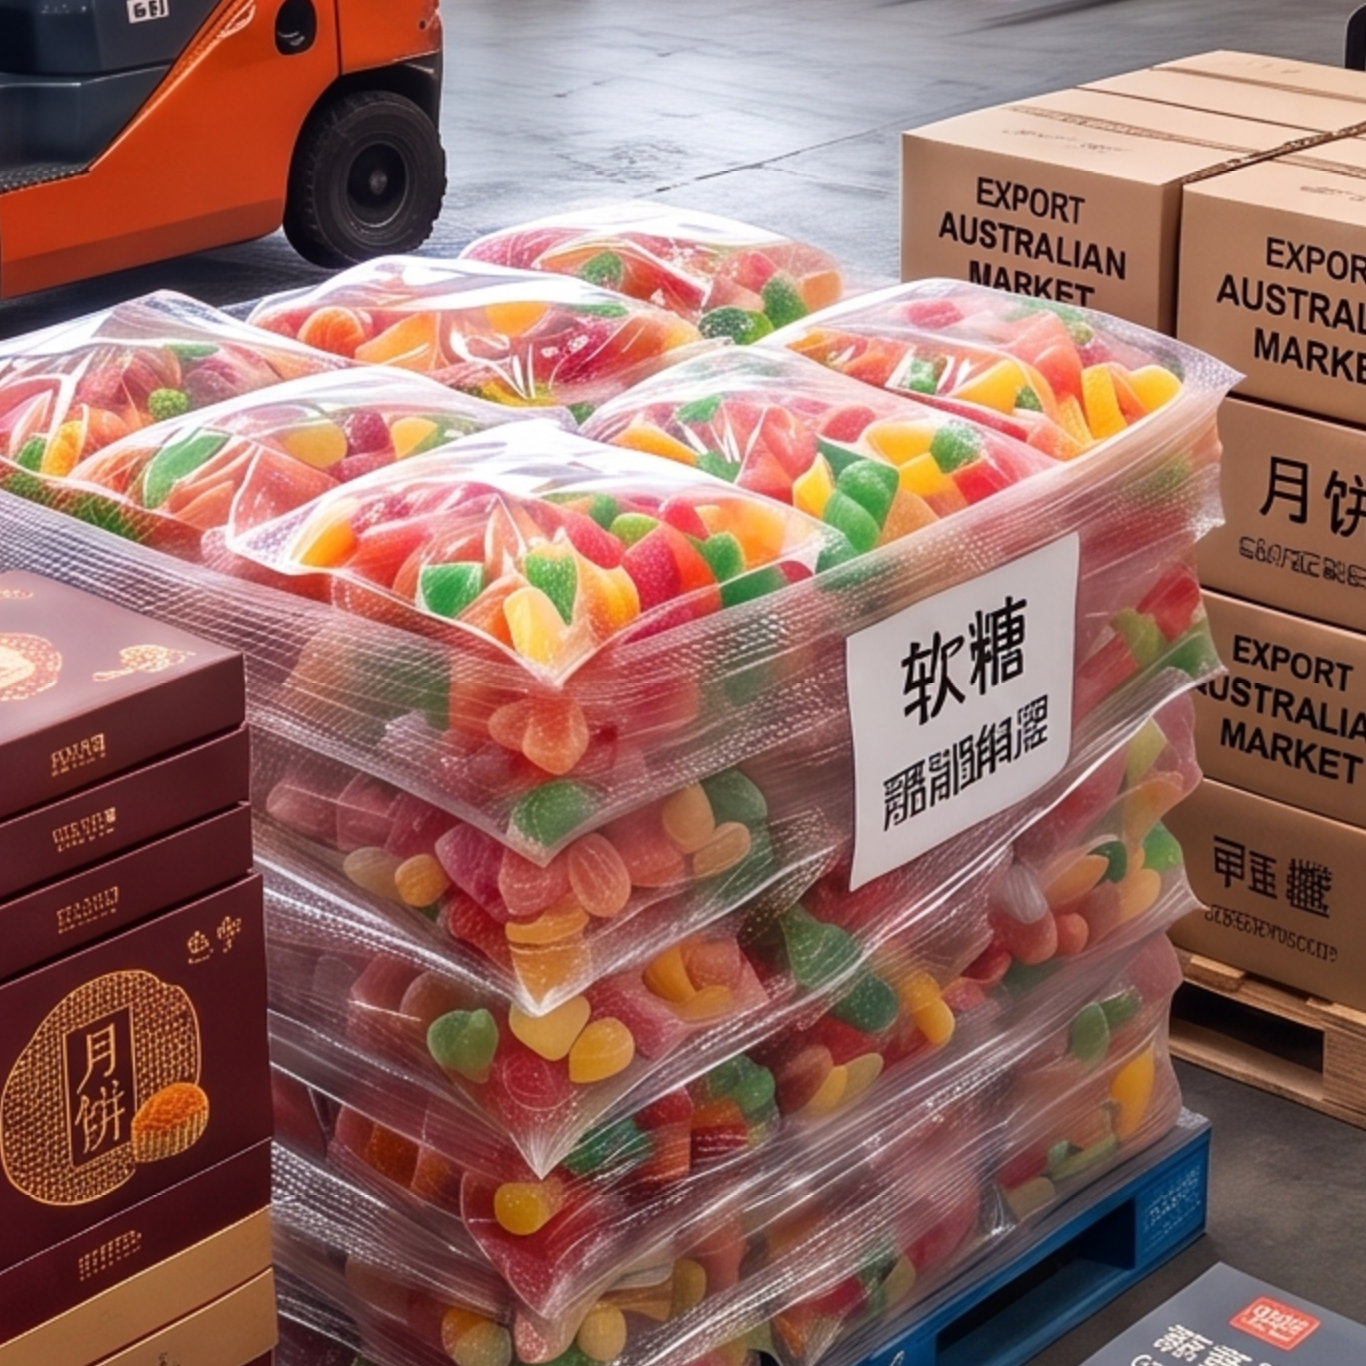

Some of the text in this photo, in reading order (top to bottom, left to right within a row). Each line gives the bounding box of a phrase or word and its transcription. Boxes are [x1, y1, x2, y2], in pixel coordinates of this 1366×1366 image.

[977, 177, 1085, 224] EXPORT
[939, 212, 1125, 279] AUSTRALIAN
[901, 598, 1027, 725] 软糖
[1233, 635, 1353, 691] EXPORT
[1221, 719, 1363, 784] MARKET
